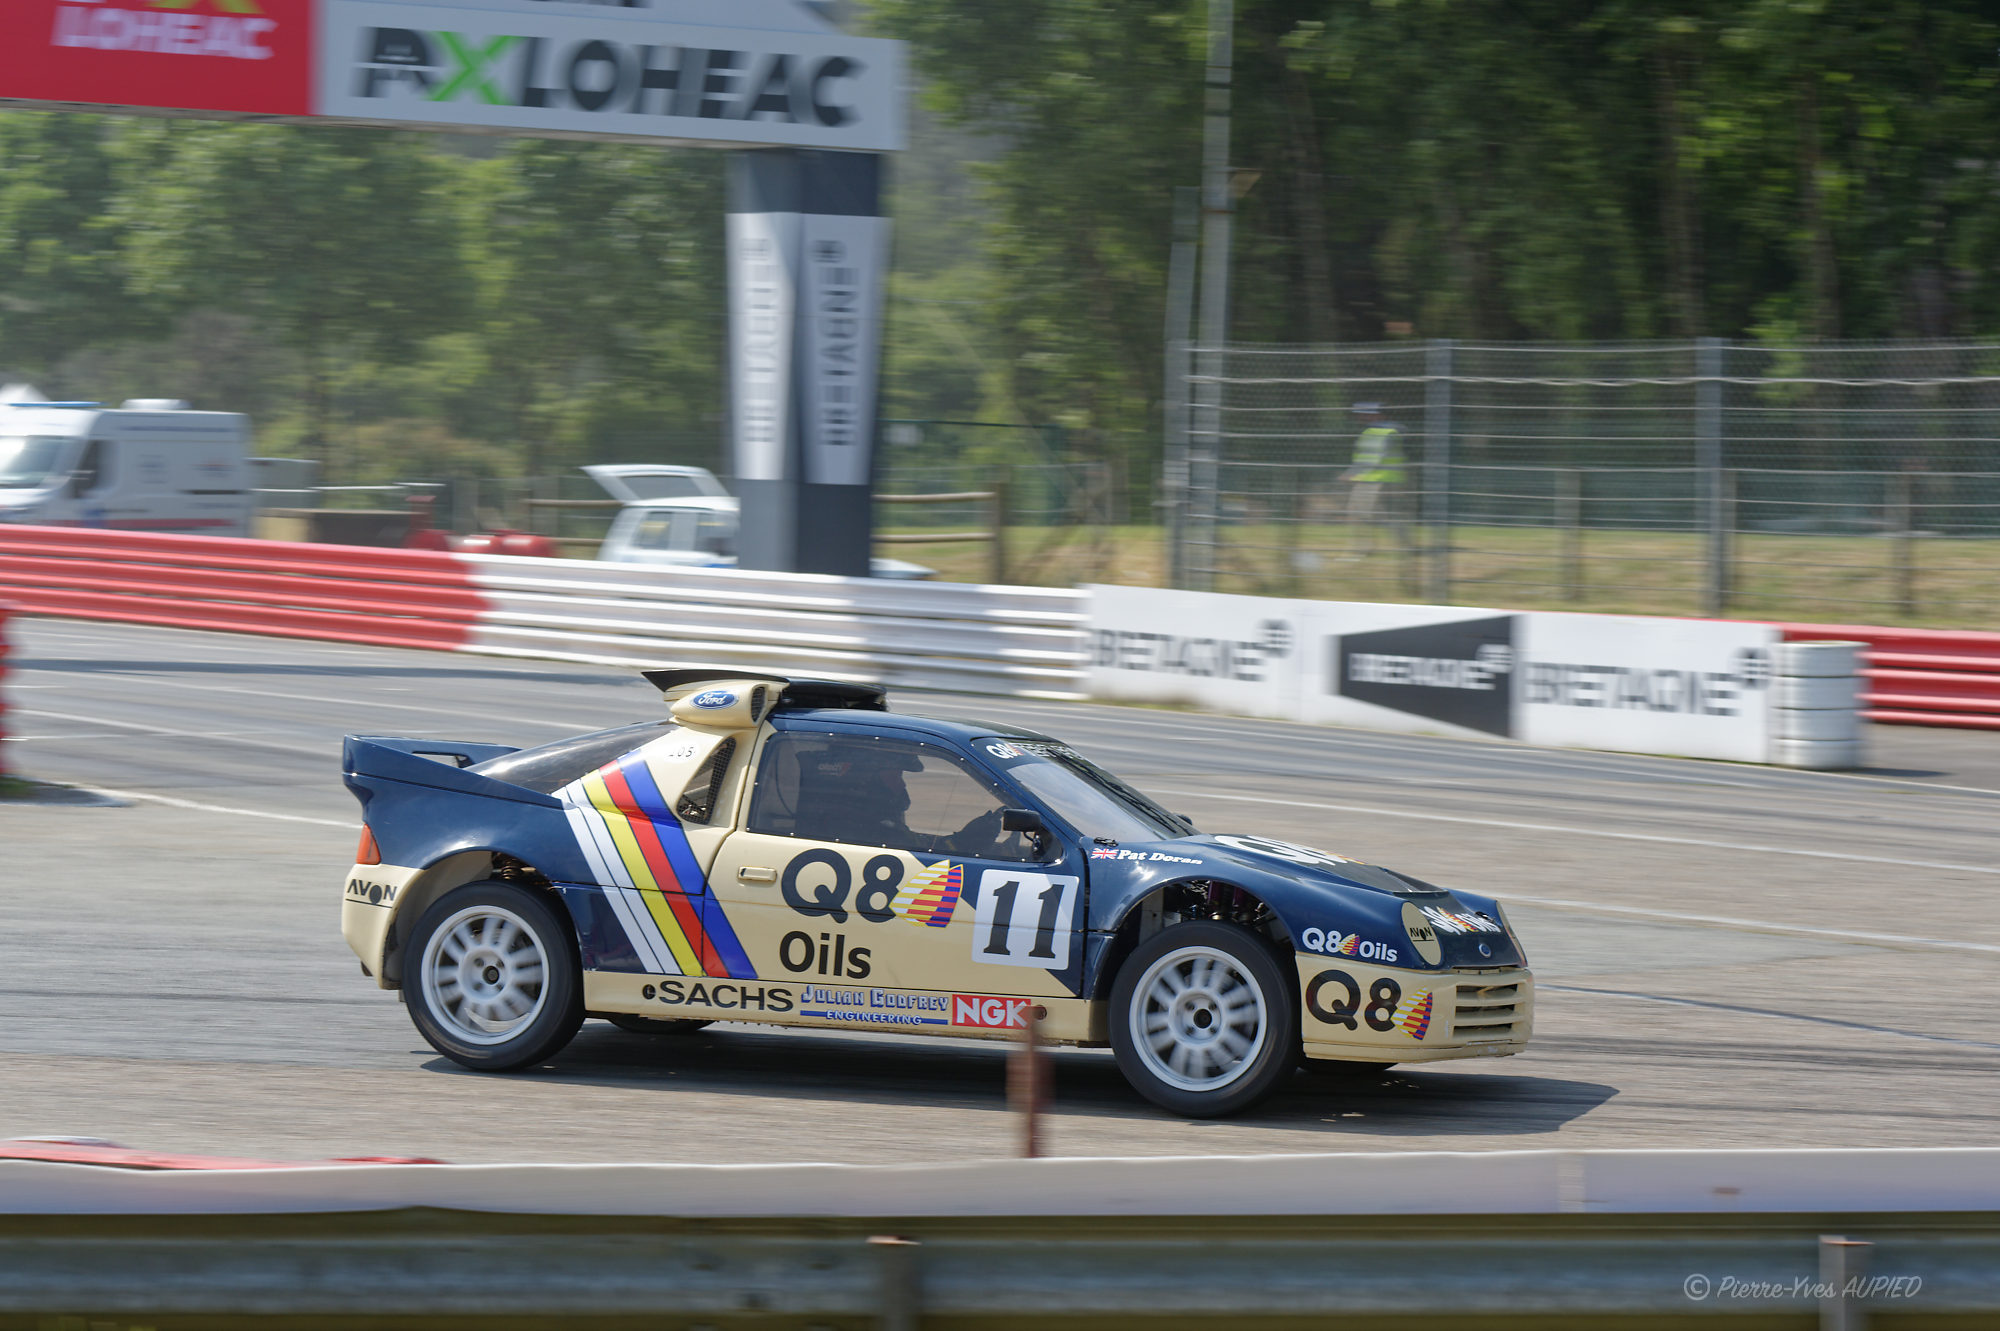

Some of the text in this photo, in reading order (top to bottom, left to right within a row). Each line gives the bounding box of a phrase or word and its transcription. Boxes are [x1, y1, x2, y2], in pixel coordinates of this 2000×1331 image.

[520, 36, 867, 128] LOHEAC
[698, 692, 729, 706] Ford
[1117, 849, 1148, 861] Pat
[347, 878, 398, 906] AVON
[780, 848, 905, 924] Q8
[983, 880, 1066, 960] 11
[1409, 926, 1433, 940] AVON
[779, 930, 872, 980] Oils
[1302, 927, 1398, 962] Q8 Oils
[659, 980, 794, 1013] SACHS
[801, 984, 949, 1011] JULIAN GODFREY
[956, 996, 1029, 1028] NGK
[1305, 969, 1402, 1032] Q8
[826, 1009, 923, 1026] ENGINEERING
